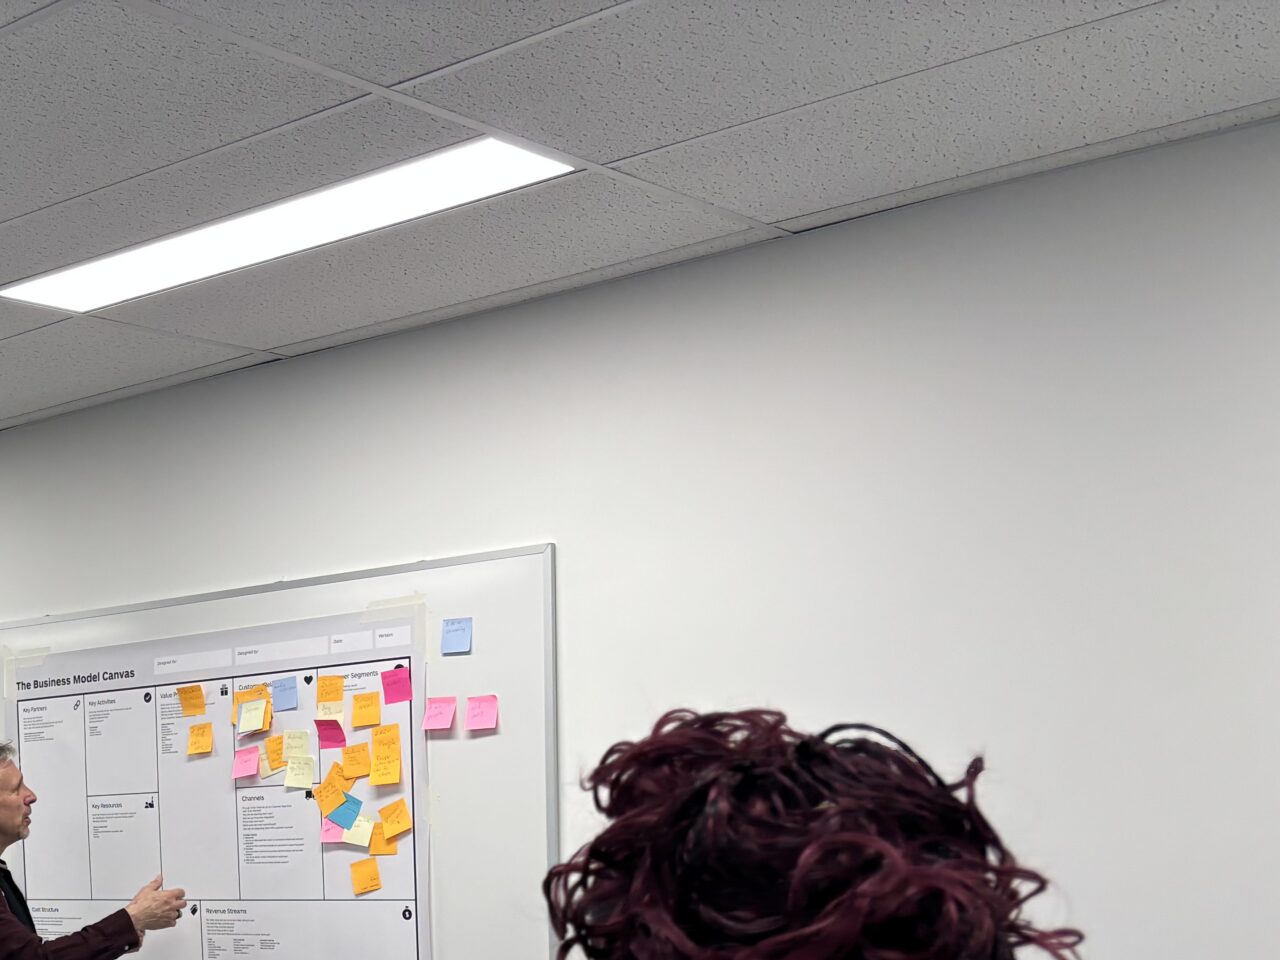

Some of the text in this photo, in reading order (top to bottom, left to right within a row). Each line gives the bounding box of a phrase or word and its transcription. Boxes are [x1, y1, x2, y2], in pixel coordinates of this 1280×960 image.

[350, 670, 379, 679] Segments
[16, 669, 135, 691] The Business Model Canvas
[160, 691, 173, 699] Value
[97, 698, 116, 706] Activities
